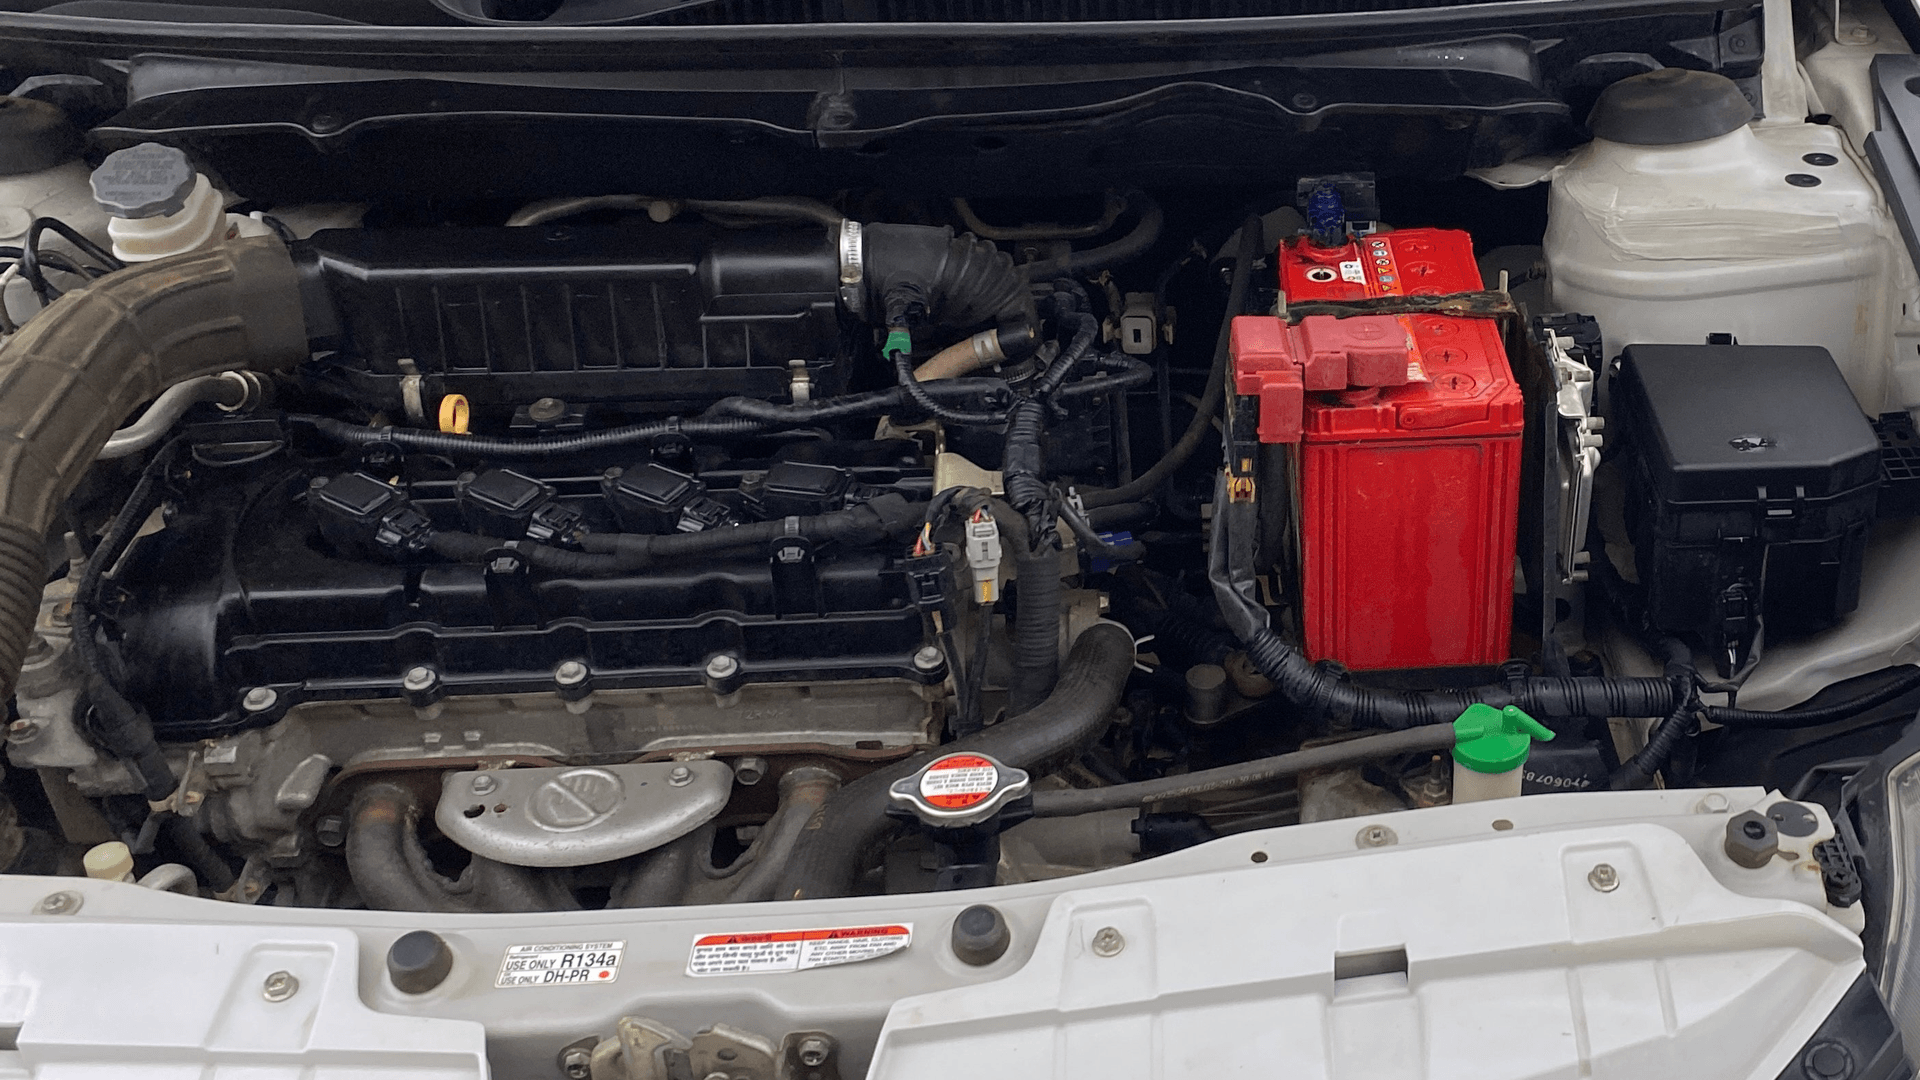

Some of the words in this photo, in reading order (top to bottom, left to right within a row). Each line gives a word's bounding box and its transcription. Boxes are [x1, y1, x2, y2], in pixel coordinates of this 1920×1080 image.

[506, 960, 527, 971] USE
[529, 959, 557, 970] ONLY
[561, 952, 617, 968] R134a
[501, 976, 517, 985] USE
[519, 975, 539, 984] ONLY
[544, 969, 590, 983] DH-PR
